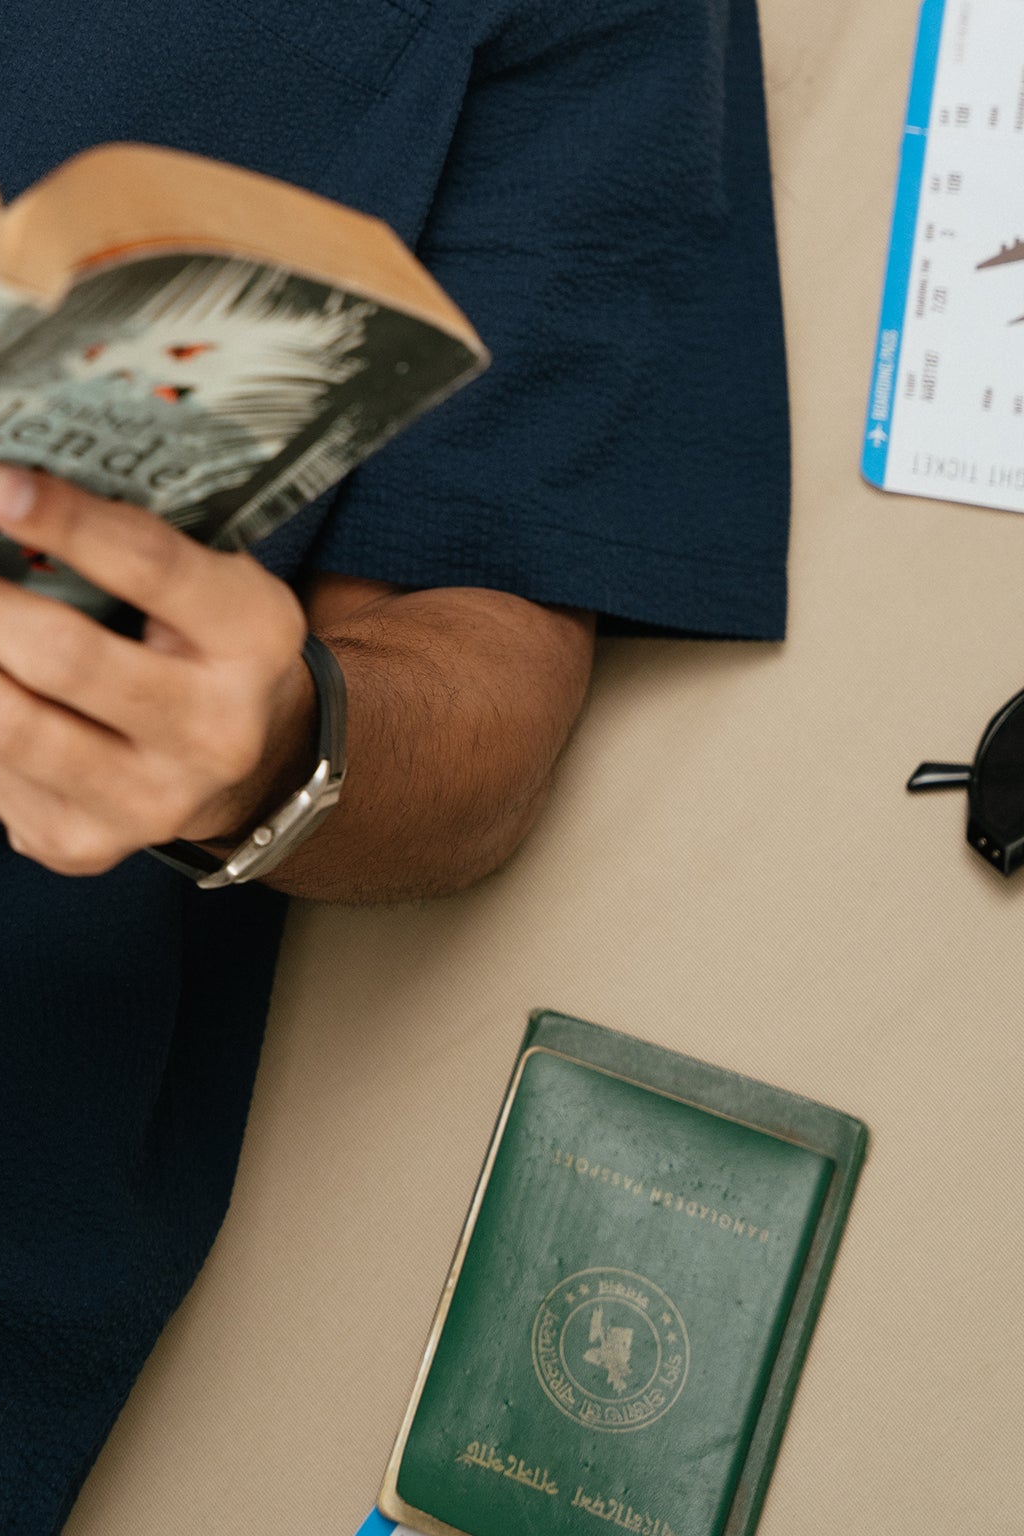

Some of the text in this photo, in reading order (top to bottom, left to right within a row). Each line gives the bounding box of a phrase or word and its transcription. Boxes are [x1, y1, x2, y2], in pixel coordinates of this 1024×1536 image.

[552, 1148, 769, 1243] BANGLADESH PASSPORT
[455, 1440, 559, 1495] পাসপোর্ট
